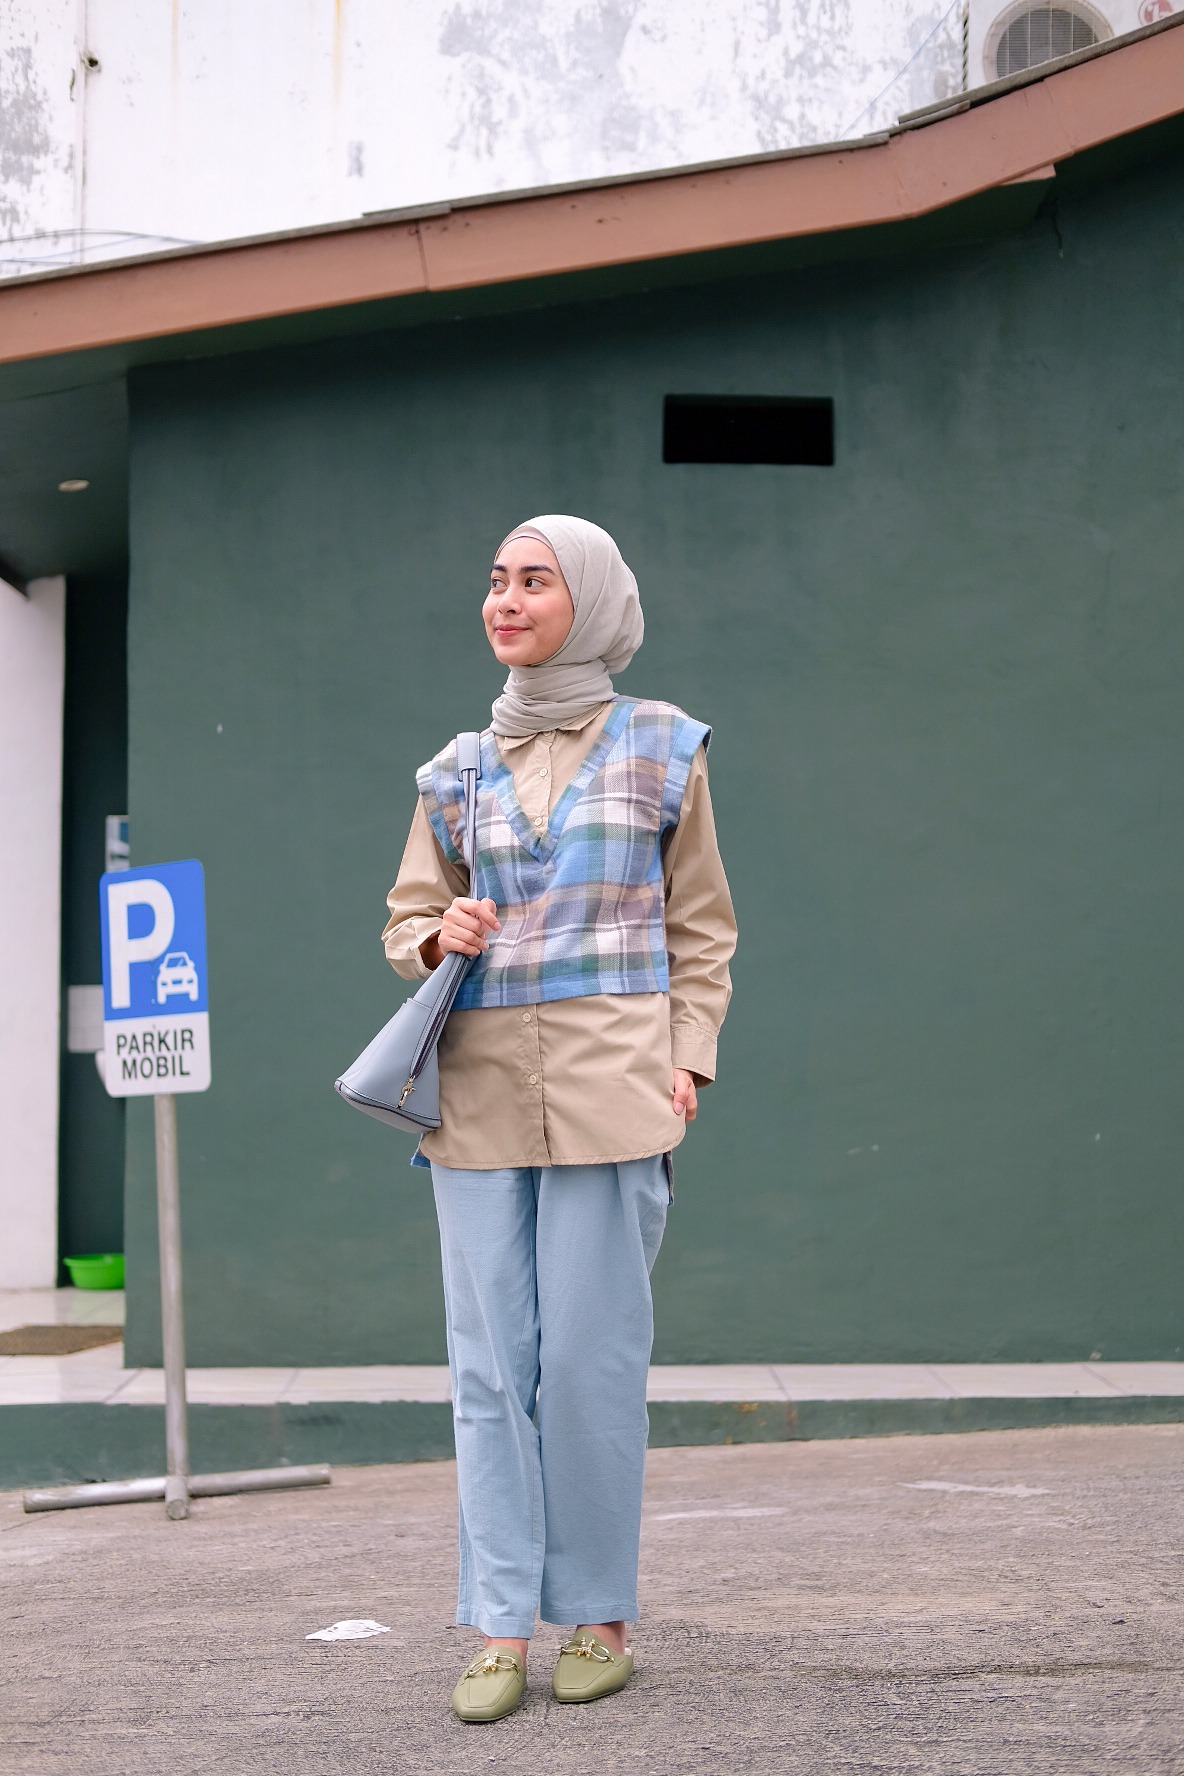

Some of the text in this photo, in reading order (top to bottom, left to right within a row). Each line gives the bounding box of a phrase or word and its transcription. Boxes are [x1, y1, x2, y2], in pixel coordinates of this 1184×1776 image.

[107, 878, 175, 1009] P
[116, 1028, 195, 1056] PARKIR
[122, 1055, 191, 1080] MOBIL
